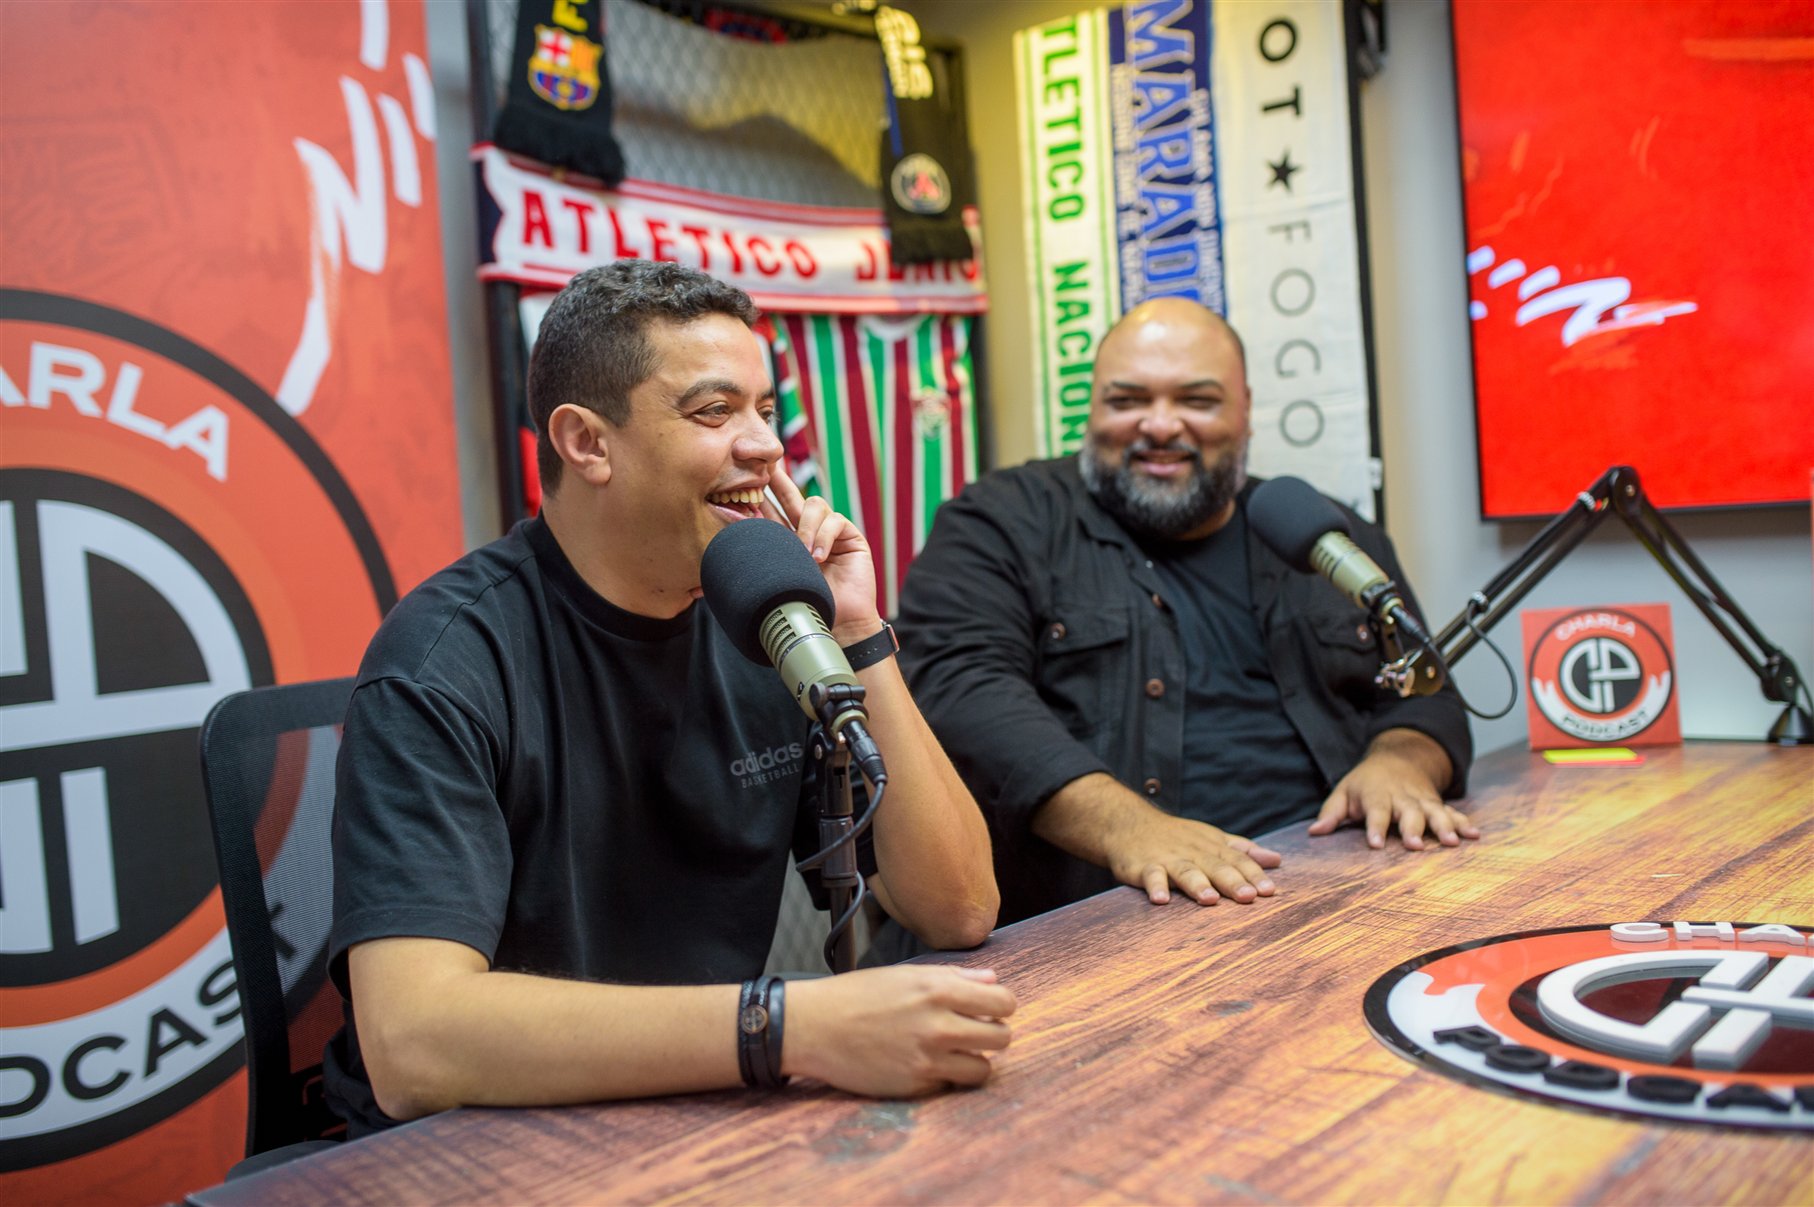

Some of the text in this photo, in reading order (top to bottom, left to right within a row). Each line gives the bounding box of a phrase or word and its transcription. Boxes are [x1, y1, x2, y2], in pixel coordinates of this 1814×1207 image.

[1126, 0, 1203, 299] MARAD
[522, 188, 819, 280] ATLETICO
[1054, 262, 1095, 456] NACION
[1554, 612, 1636, 641] CHARLA
[730, 742, 804, 776] adidas
[741, 763, 800, 789] BASKETBALL
[1609, 921, 1814, 946] CHA
[1433, 1023, 1814, 1114] PODCA
